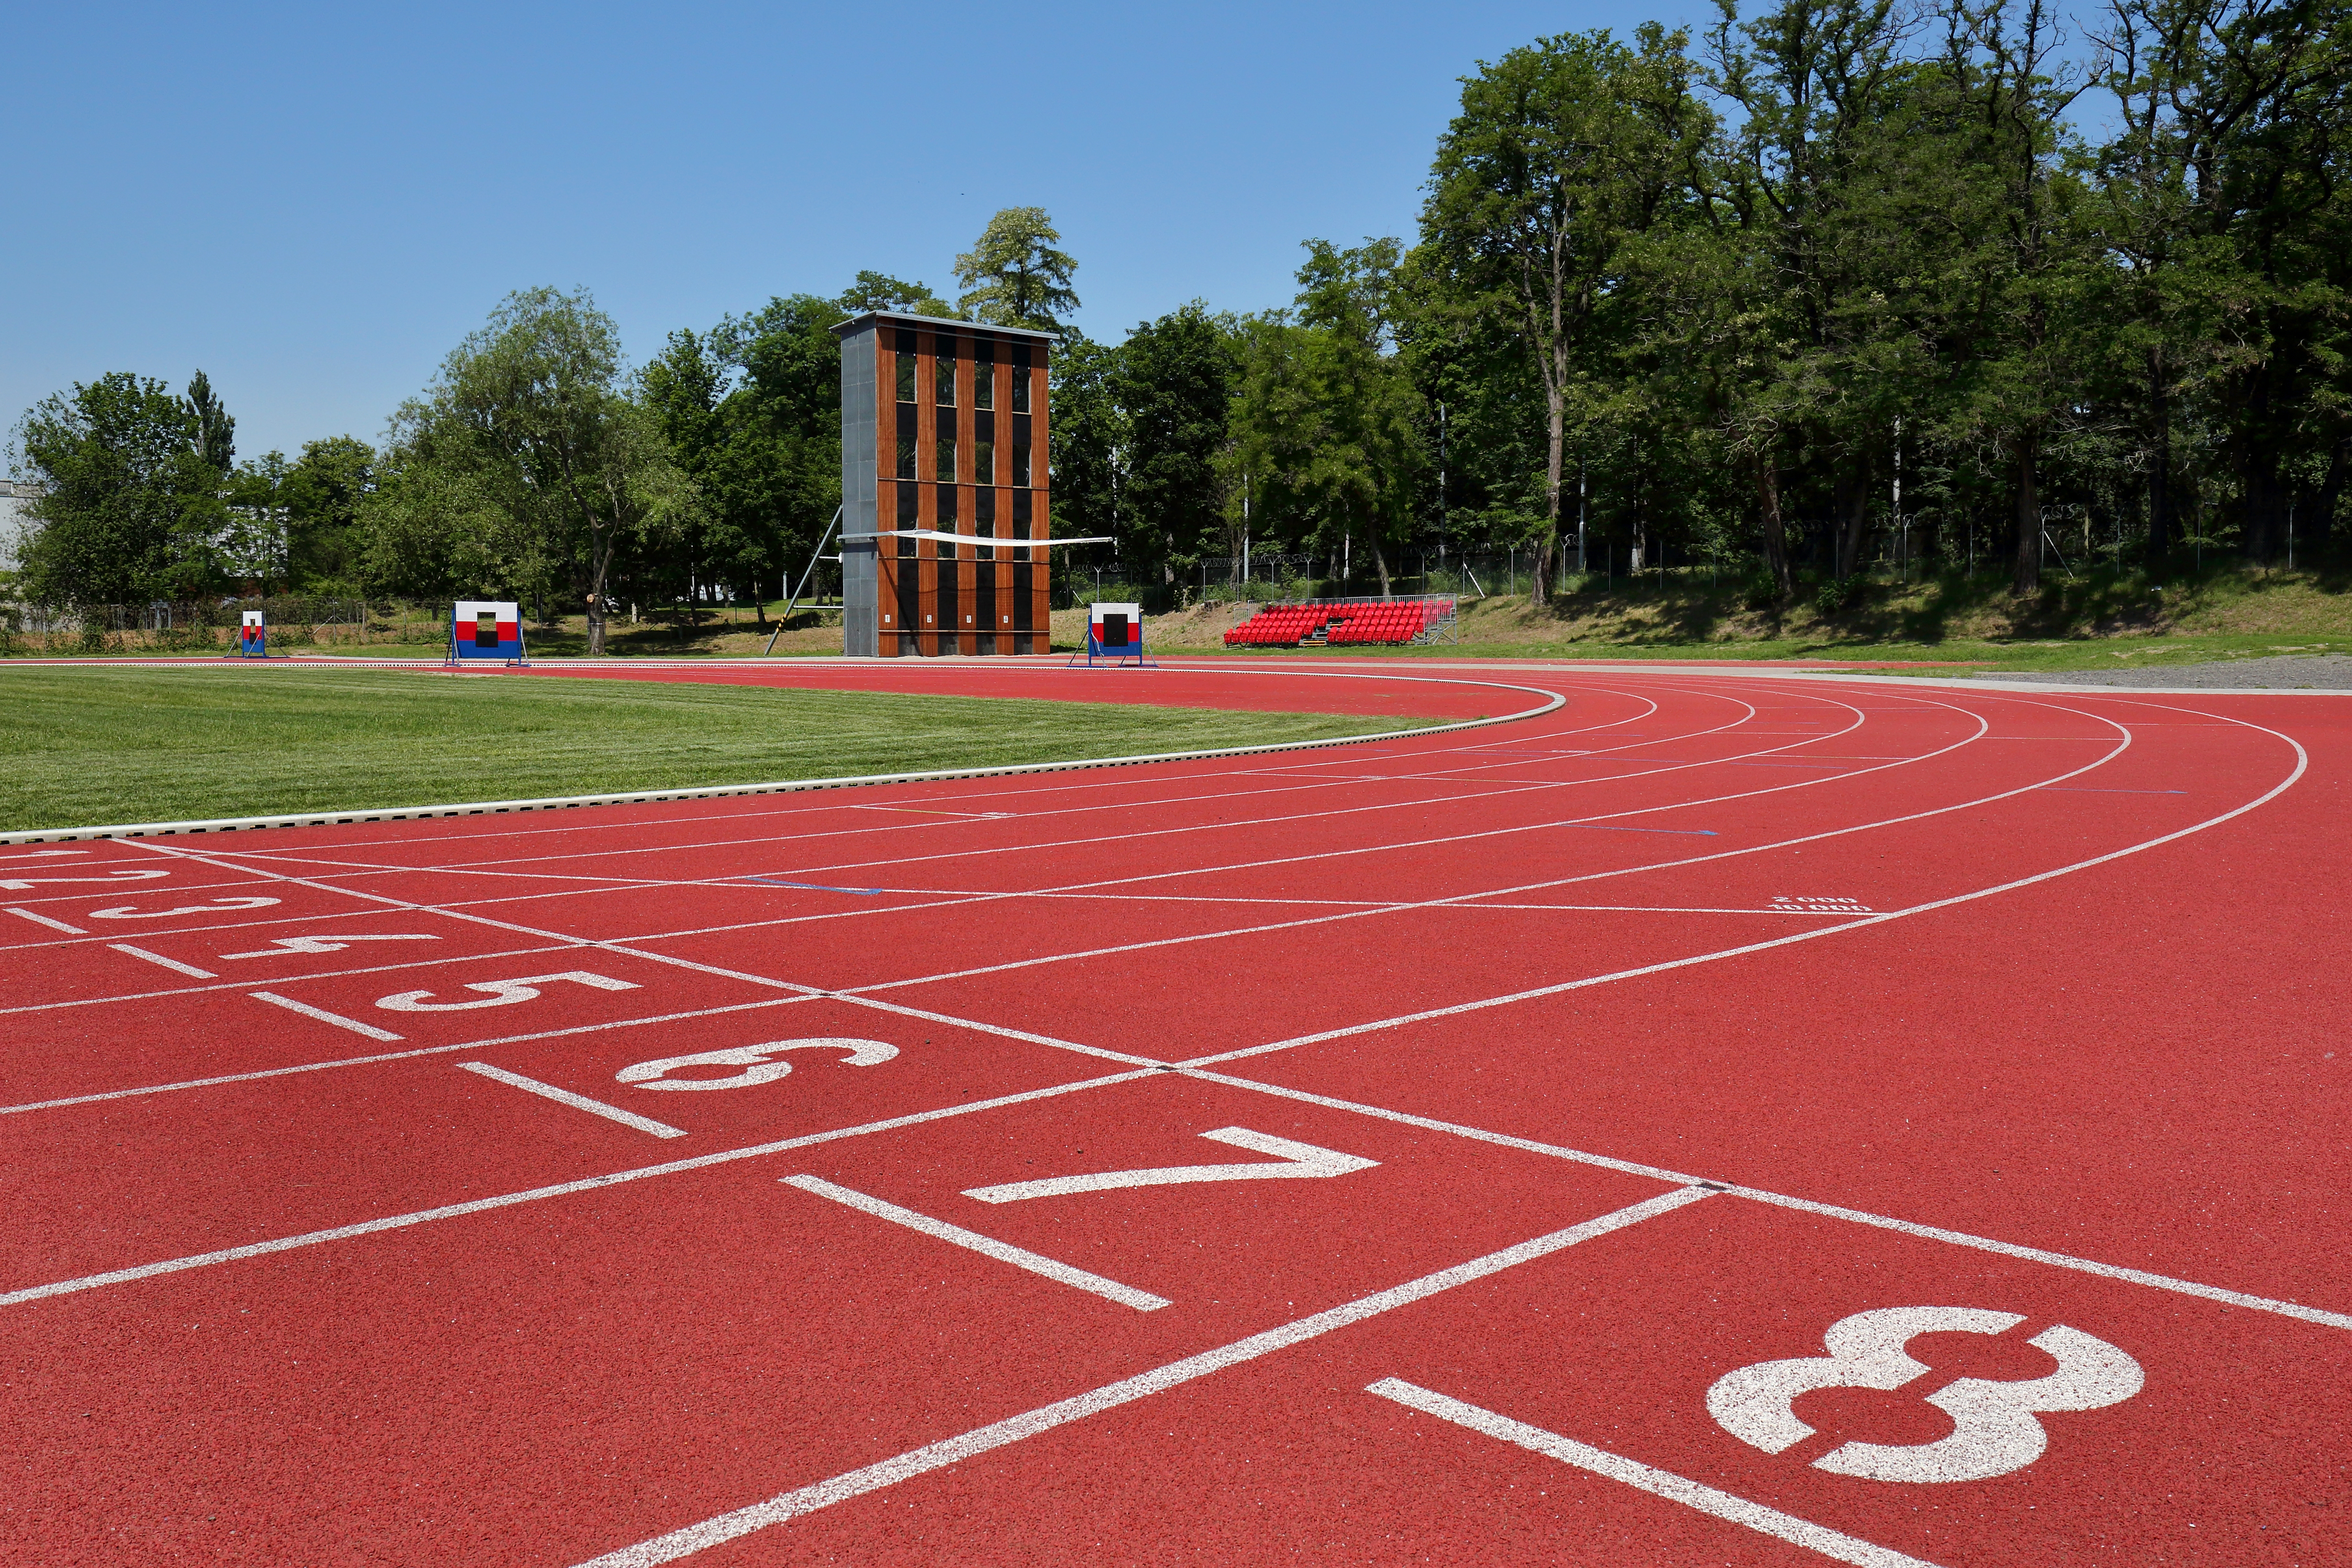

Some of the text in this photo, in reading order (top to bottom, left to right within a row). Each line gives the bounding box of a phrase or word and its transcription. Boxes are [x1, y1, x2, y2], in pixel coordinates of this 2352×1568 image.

[0, 870, 171, 890] 2
[88, 897, 282, 919] 3
[218, 934, 443, 960] 4
[375, 970, 644, 1012] 5
[615, 1037, 900, 1091] 6
[959, 1125, 1383, 1204] 7
[1706, 1304, 2146, 1484] 8
